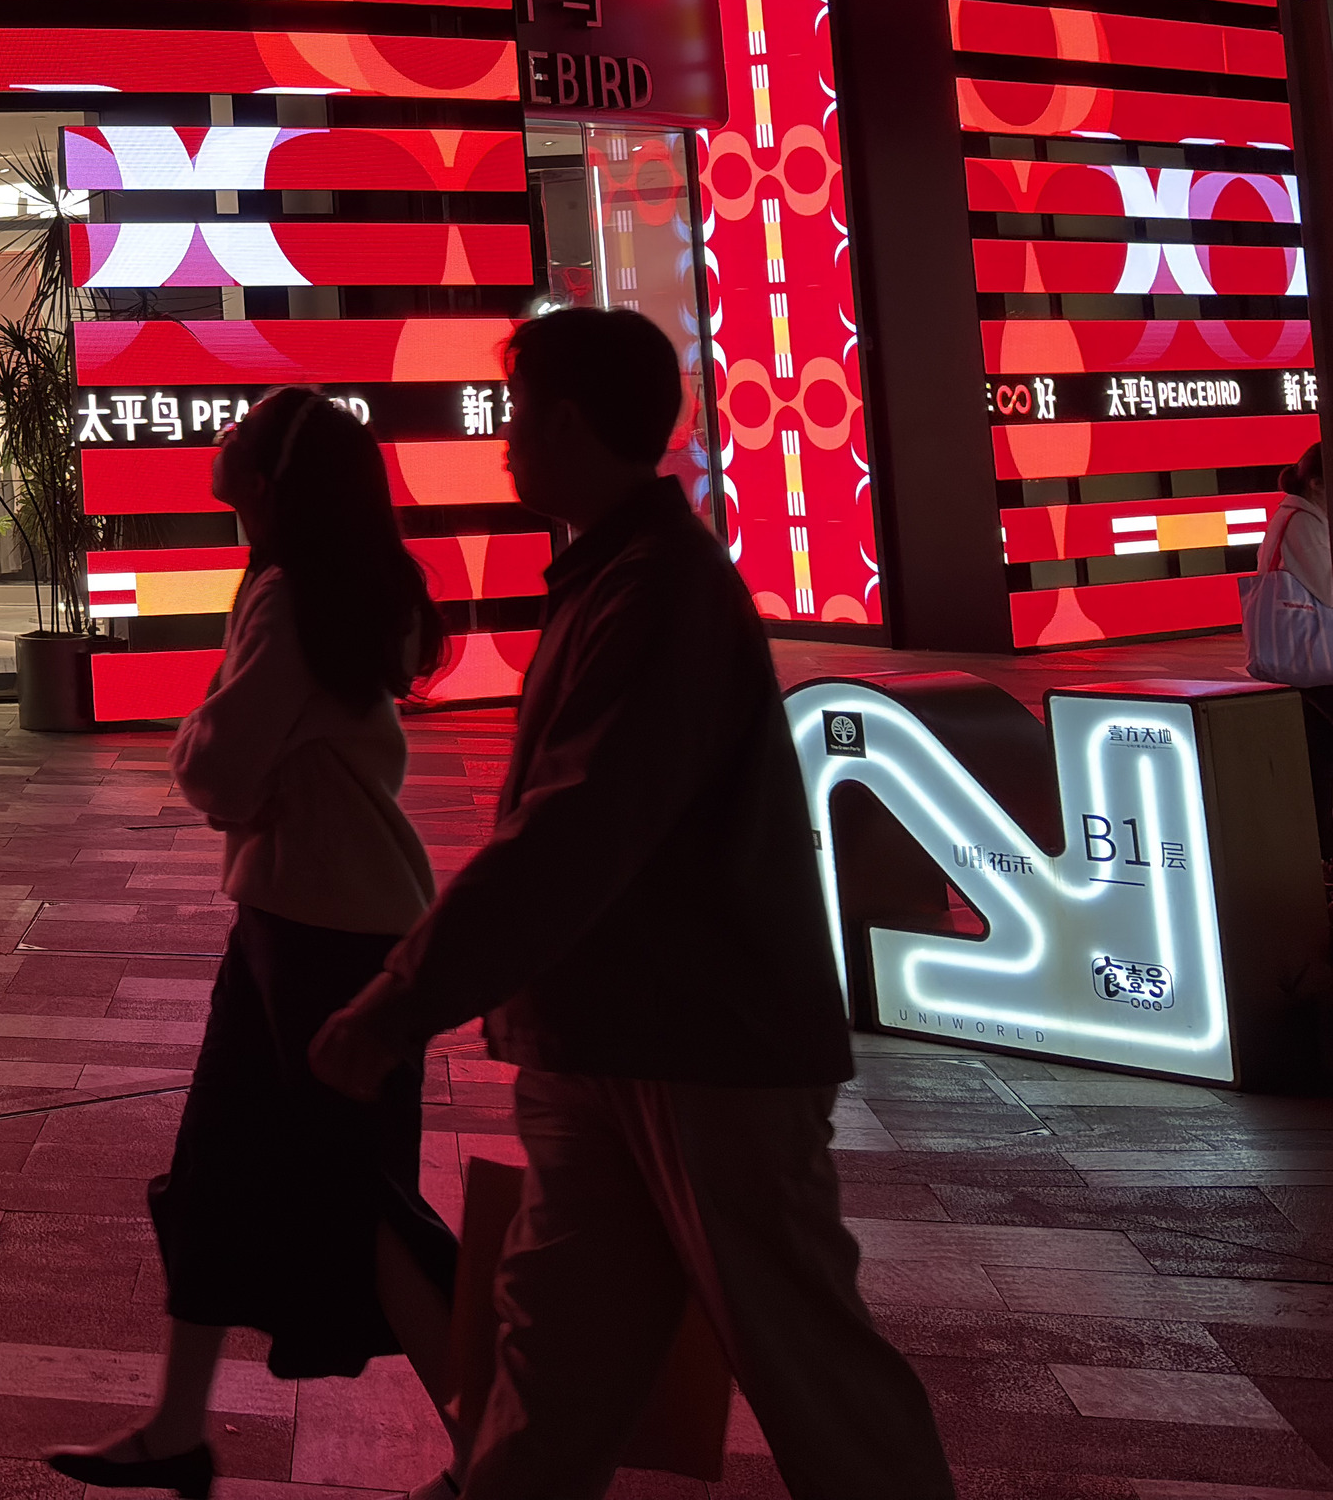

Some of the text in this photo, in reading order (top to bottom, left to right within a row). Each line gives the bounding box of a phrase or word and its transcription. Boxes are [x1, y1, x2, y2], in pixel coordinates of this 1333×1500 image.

[1106, 376, 1241, 417] 太平鸟 PEACEBIRD
[1283, 370, 1318, 413] 新年
[77, 391, 183, 443] 太平鸟
[1107, 725, 1173, 745] 壹方天地
[899, 1009, 1045, 1043] UNIWORLD
